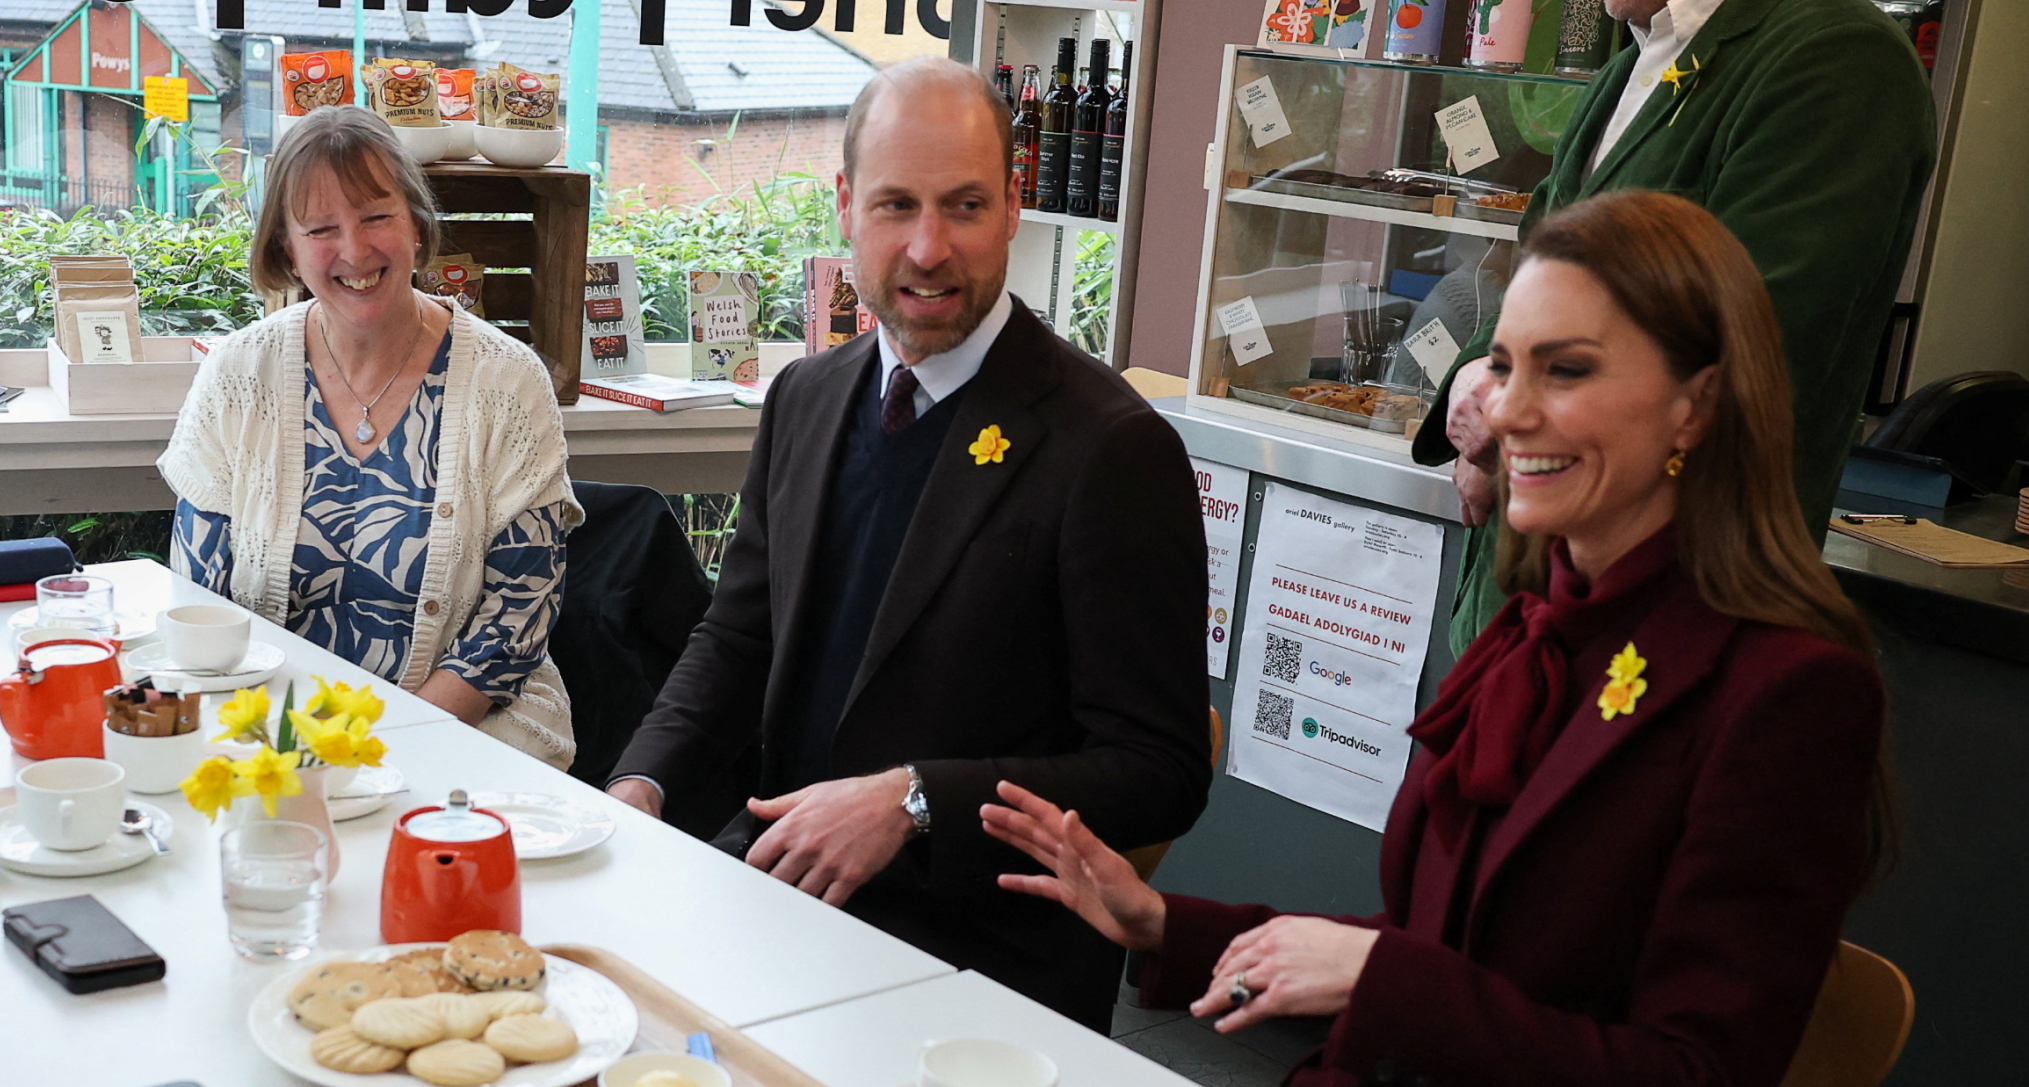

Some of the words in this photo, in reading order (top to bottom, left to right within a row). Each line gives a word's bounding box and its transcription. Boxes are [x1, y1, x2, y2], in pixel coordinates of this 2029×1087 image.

[1479, 36, 1497, 47] Pale
[91, 52, 131, 73] Powys
[384, 108, 416, 118] PREMIUM
[417, 108, 434, 117] NUTS
[1446, 110, 1468, 124] ALMOND
[505, 118, 536, 127] PREMIUM
[584, 284, 610, 298] BAKE
[611, 284, 619, 296] IT
[706, 299, 742, 312] Welsh
[711, 311, 739, 326] Food
[589, 321, 616, 334] SLICE
[616, 320, 624, 332] IT
[708, 327, 747, 340] Stories
[1405, 334, 1422, 348] BARA
[1421, 320, 1440, 337] BRITH
[597, 357, 616, 370] EAT
[616, 357, 625, 369] IT
[585, 384, 603, 396] BAKE
[602, 388, 609, 398] IT
[608, 389, 627, 402] SLICE
[626, 393, 633, 404] IT
[633, 395, 645, 406] EAT
[645, 398, 652, 408] IT
[1196, 470, 1212, 492] OD
[1200, 496, 1239, 523] ERGY?
[1285, 508, 1300, 516] oriel
[1300, 509, 1332, 525] DAVIES
[1333, 522, 1355, 533] gallery
[1221, 548, 1229, 556] or
[1271, 577, 1308, 595] PLEASE
[1310, 587, 1341, 605] LEAVE
[1343, 597, 1357, 609] US
[1360, 602, 1367, 613] A
[1370, 605, 1412, 625] REVIEW
[1268, 603, 1311, 625] GADAEL
[1314, 618, 1381, 646] ADOLYGIAD
[1383, 638, 1388, 648] I
[1391, 640, 1406, 653] NI
[1309, 660, 1352, 686] Google
[1319, 724, 1382, 757] Tripadvisor
